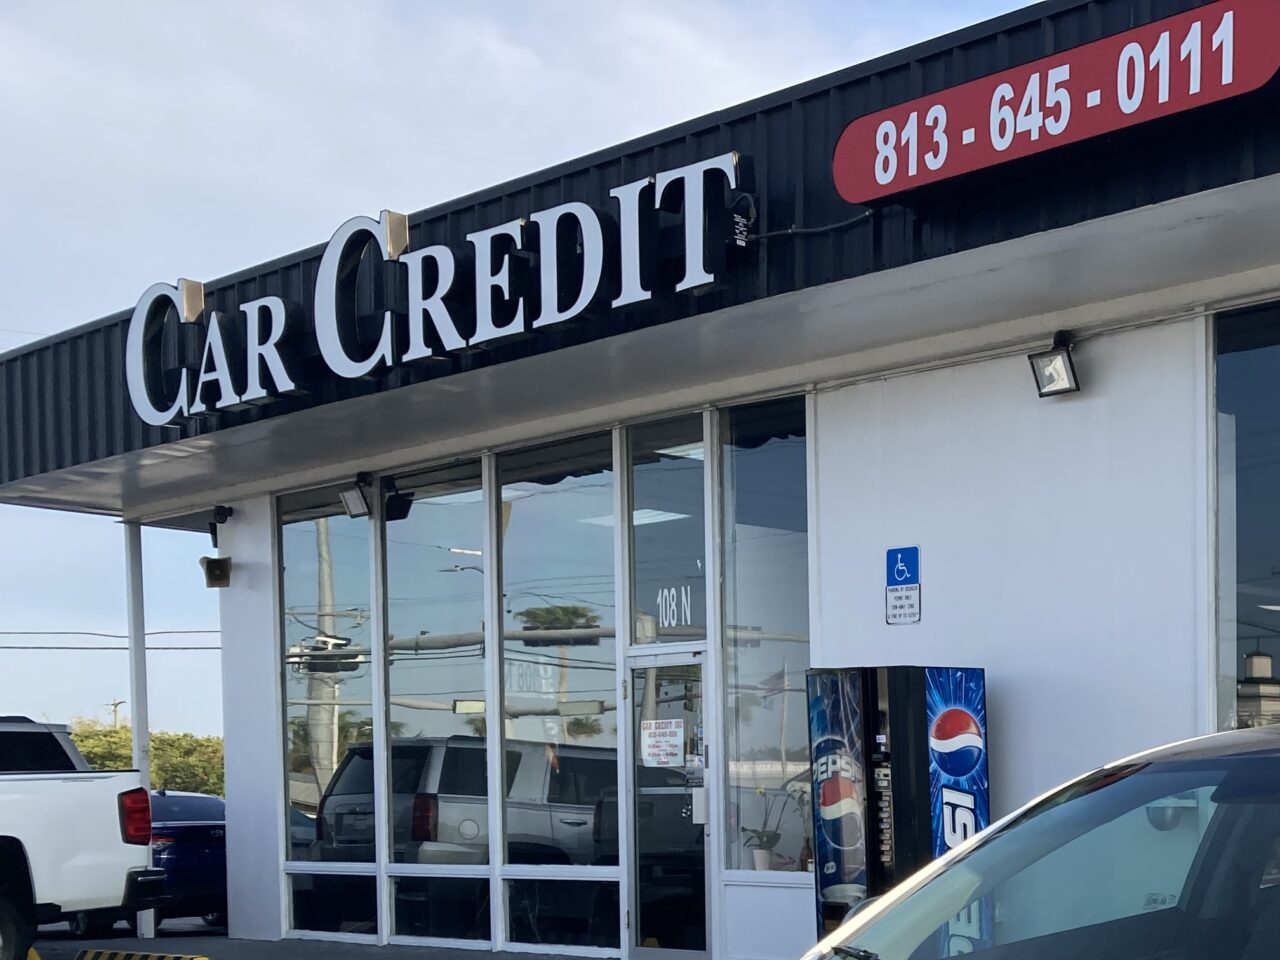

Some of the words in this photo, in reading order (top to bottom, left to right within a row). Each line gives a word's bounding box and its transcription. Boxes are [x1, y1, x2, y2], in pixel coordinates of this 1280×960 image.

[874, 104, 948, 185] 813
[989, 64, 1071, 151] 645
[1117, 10, 1234, 115] 0111
[126, 277, 294, 426] CAR
[314, 151, 739, 379] CREDIT
[656, 587, 677, 628] 108
[681, 585, 691, 626] N
